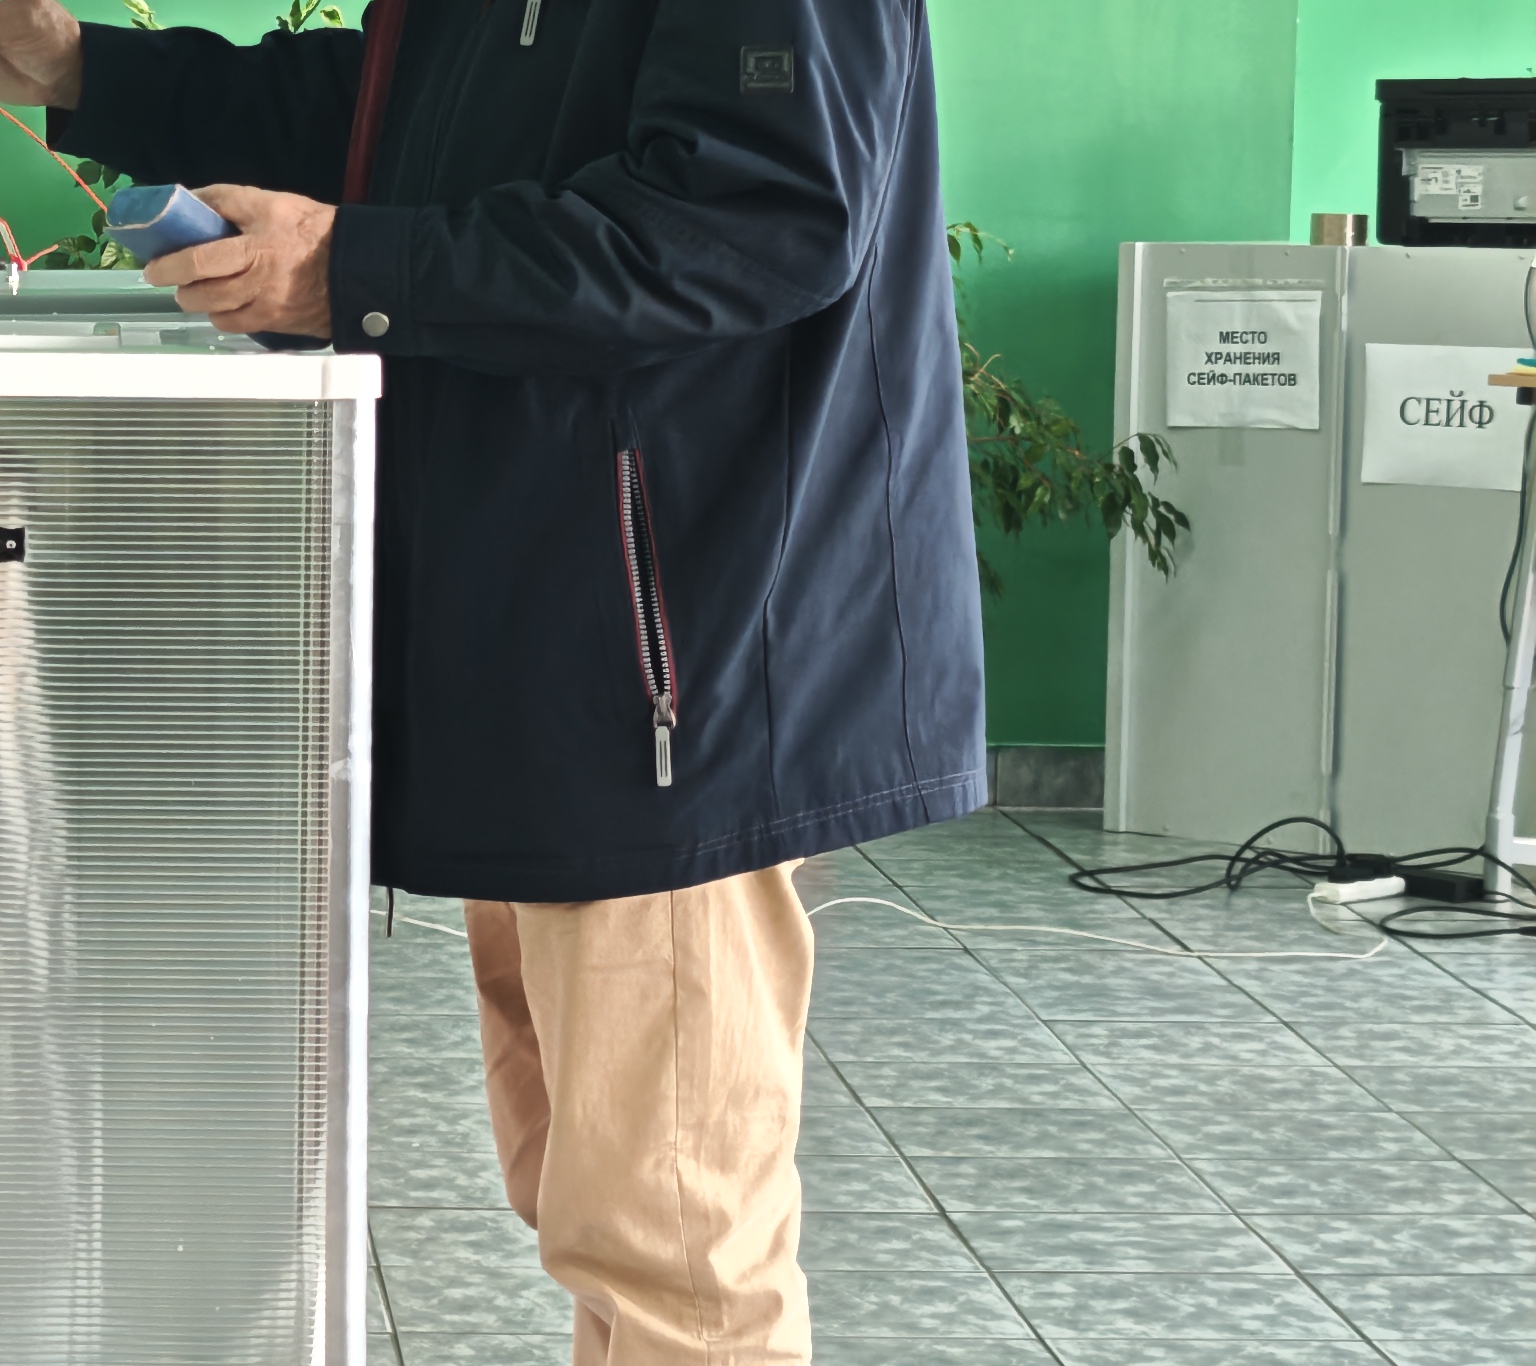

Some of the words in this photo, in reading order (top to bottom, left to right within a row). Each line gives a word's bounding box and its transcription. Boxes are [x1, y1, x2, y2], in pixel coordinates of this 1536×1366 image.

[1219, 331, 1268, 345] МЕСТО
[1204, 351, 1281, 366] ХРАНЕНИЯ
[1187, 370, 1297, 387] СЕЙФ-ПАКЕТОВ
[1399, 390, 1495, 429] СЕЙФ
